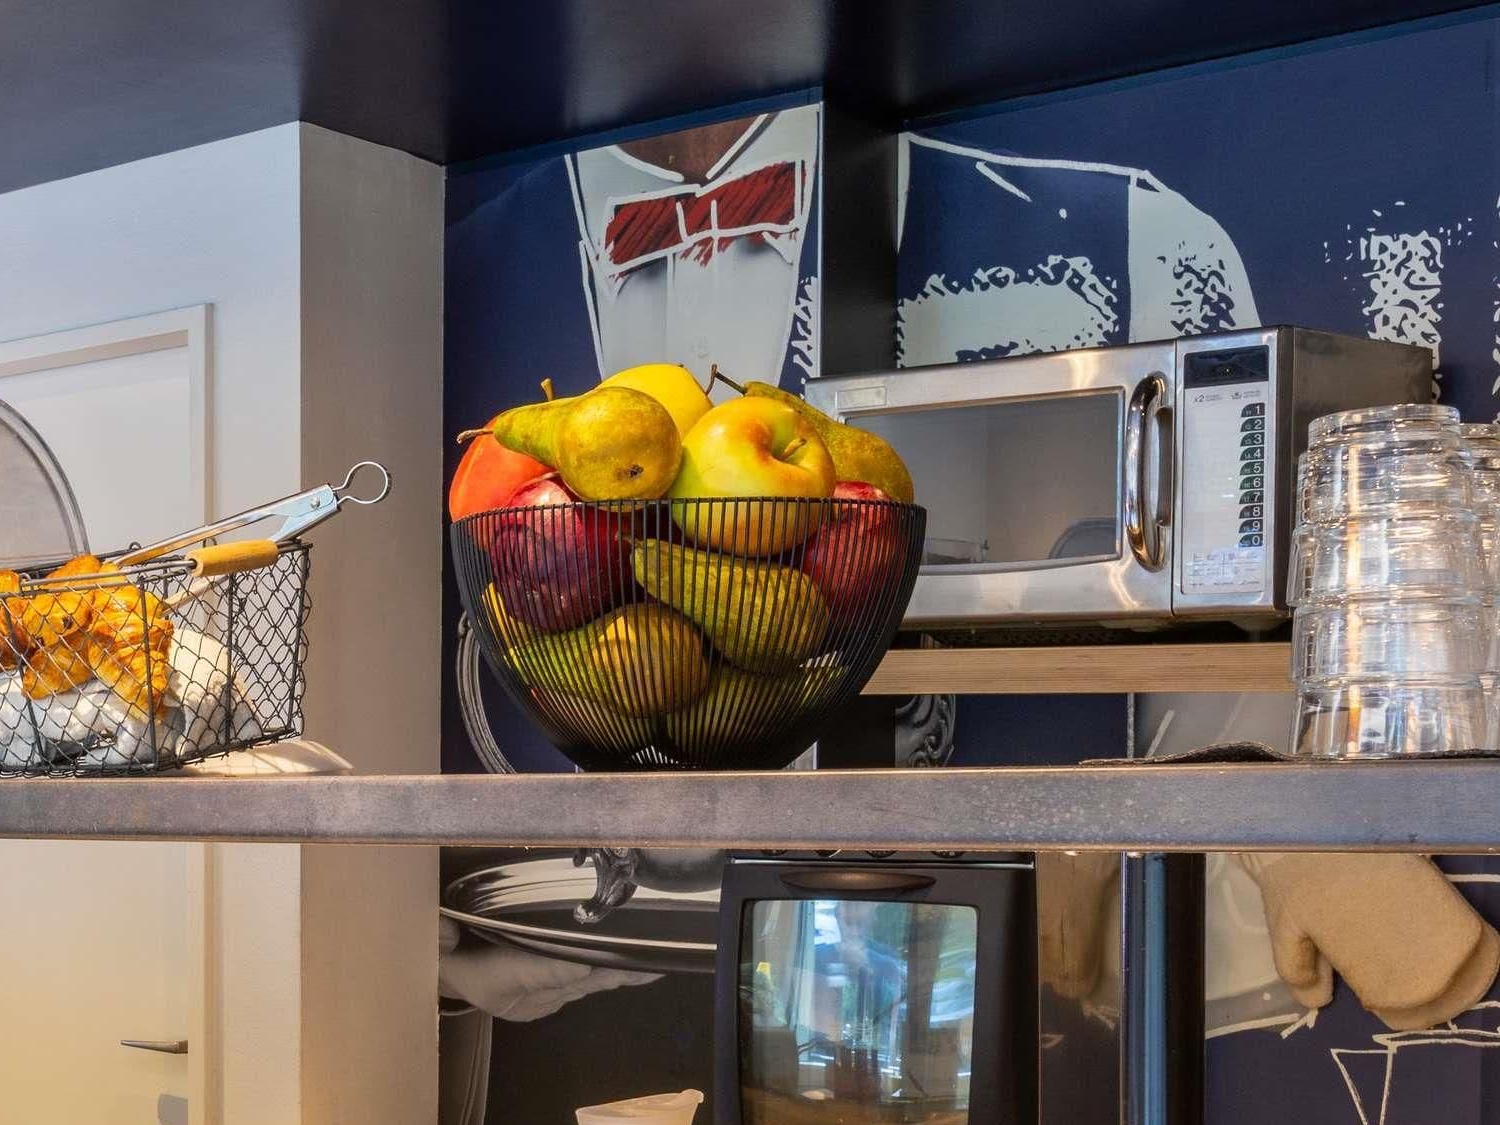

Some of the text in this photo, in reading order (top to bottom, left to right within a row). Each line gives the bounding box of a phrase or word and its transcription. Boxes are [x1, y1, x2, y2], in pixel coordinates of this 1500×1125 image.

[1256, 404, 1261, 415] 1
[1254, 419, 1262, 430] 2
[1253, 433, 1262, 445] 3
[1253, 448, 1261, 459] 4
[1253, 463, 1261, 474] 5
[1253, 477, 1261, 488] 6
[1253, 491, 1260, 502] 7
[1253, 506, 1261, 517] 8
[1252, 520, 1260, 531] 9
[1252, 535, 1260, 546] 0
